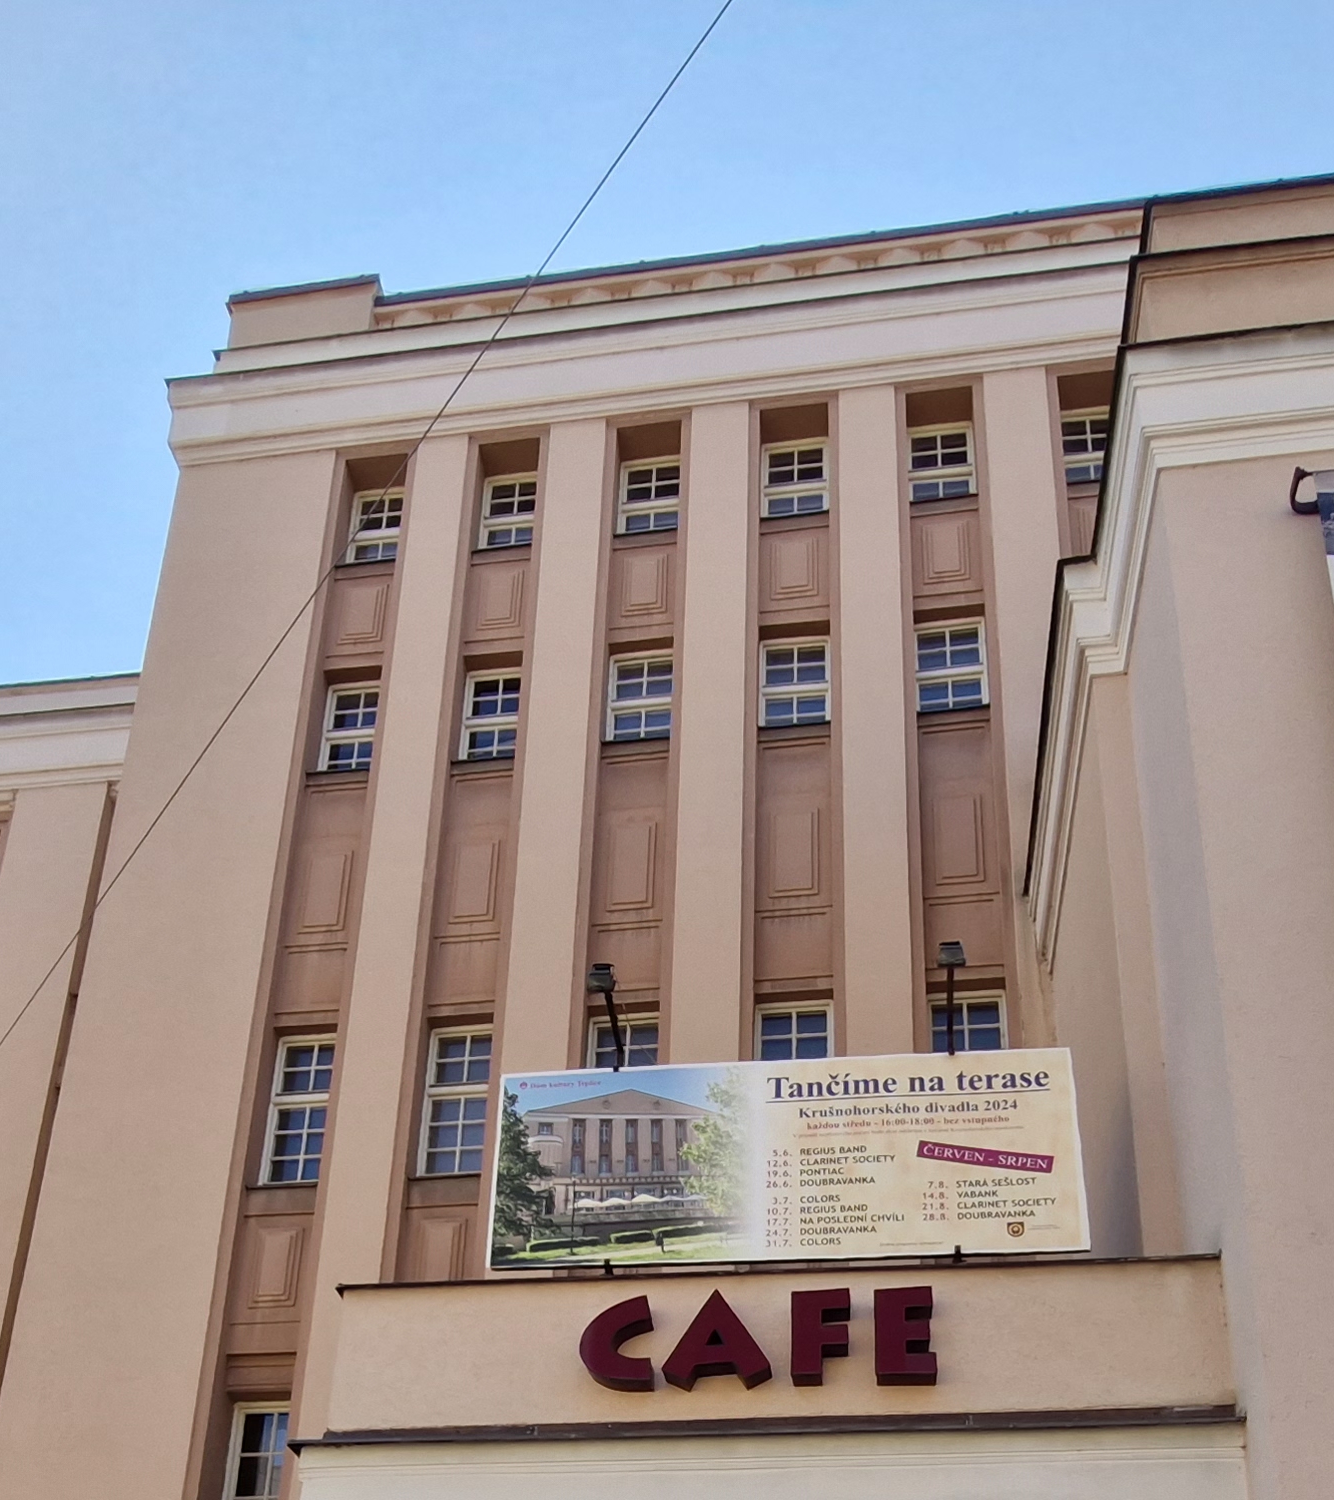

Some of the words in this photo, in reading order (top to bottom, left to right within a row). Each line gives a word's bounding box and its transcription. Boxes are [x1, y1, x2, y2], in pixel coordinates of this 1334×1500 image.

[767, 1073, 897, 1099] Tančíme
[908, 1075, 945, 1093] na
[956, 1070, 1050, 1091] terase
[798, 1104, 920, 1119] Krušnohorského
[925, 1101, 979, 1115] divadla
[984, 1099, 1018, 1112] 2024
[800, 1147, 836, 1156] REGIUS
[839, 1145, 867, 1154] BAND
[800, 1157, 849, 1167] CLARINET
[852, 1155, 896, 1164] SOCIETY
[923, 1144, 985, 1162] ČERVEN
[997, 1154, 1049, 1169] SRPEN
[800, 1167, 845, 1177] PONTIAC
[800, 1176, 876, 1187] DOUBRAVANKA
[956, 1178, 989, 1189] STARÁ
[991, 1177, 1037, 1187] SEŠLOST
[800, 1195, 841, 1204] COLORS
[956, 1190, 998, 1199] VABANK
[957, 1200, 1008, 1210] CLARINET
[1011, 1197, 1057, 1207] SOCIETY
[800, 1205, 837, 1215] REGIUS
[840, 1204, 868, 1213] BAND
[957, 1210, 1036, 1220] DOUBRAVANKA
[800, 1217, 814, 1225] NA
[817, 1213, 867, 1224] POSLEDNÍ
[870, 1212, 905, 1222] CHVÍLI
[800, 1225, 877, 1236] DOUBRAVANKA
[800, 1237, 841, 1246] COLORS
[579, 1285, 937, 1392] CAFE
